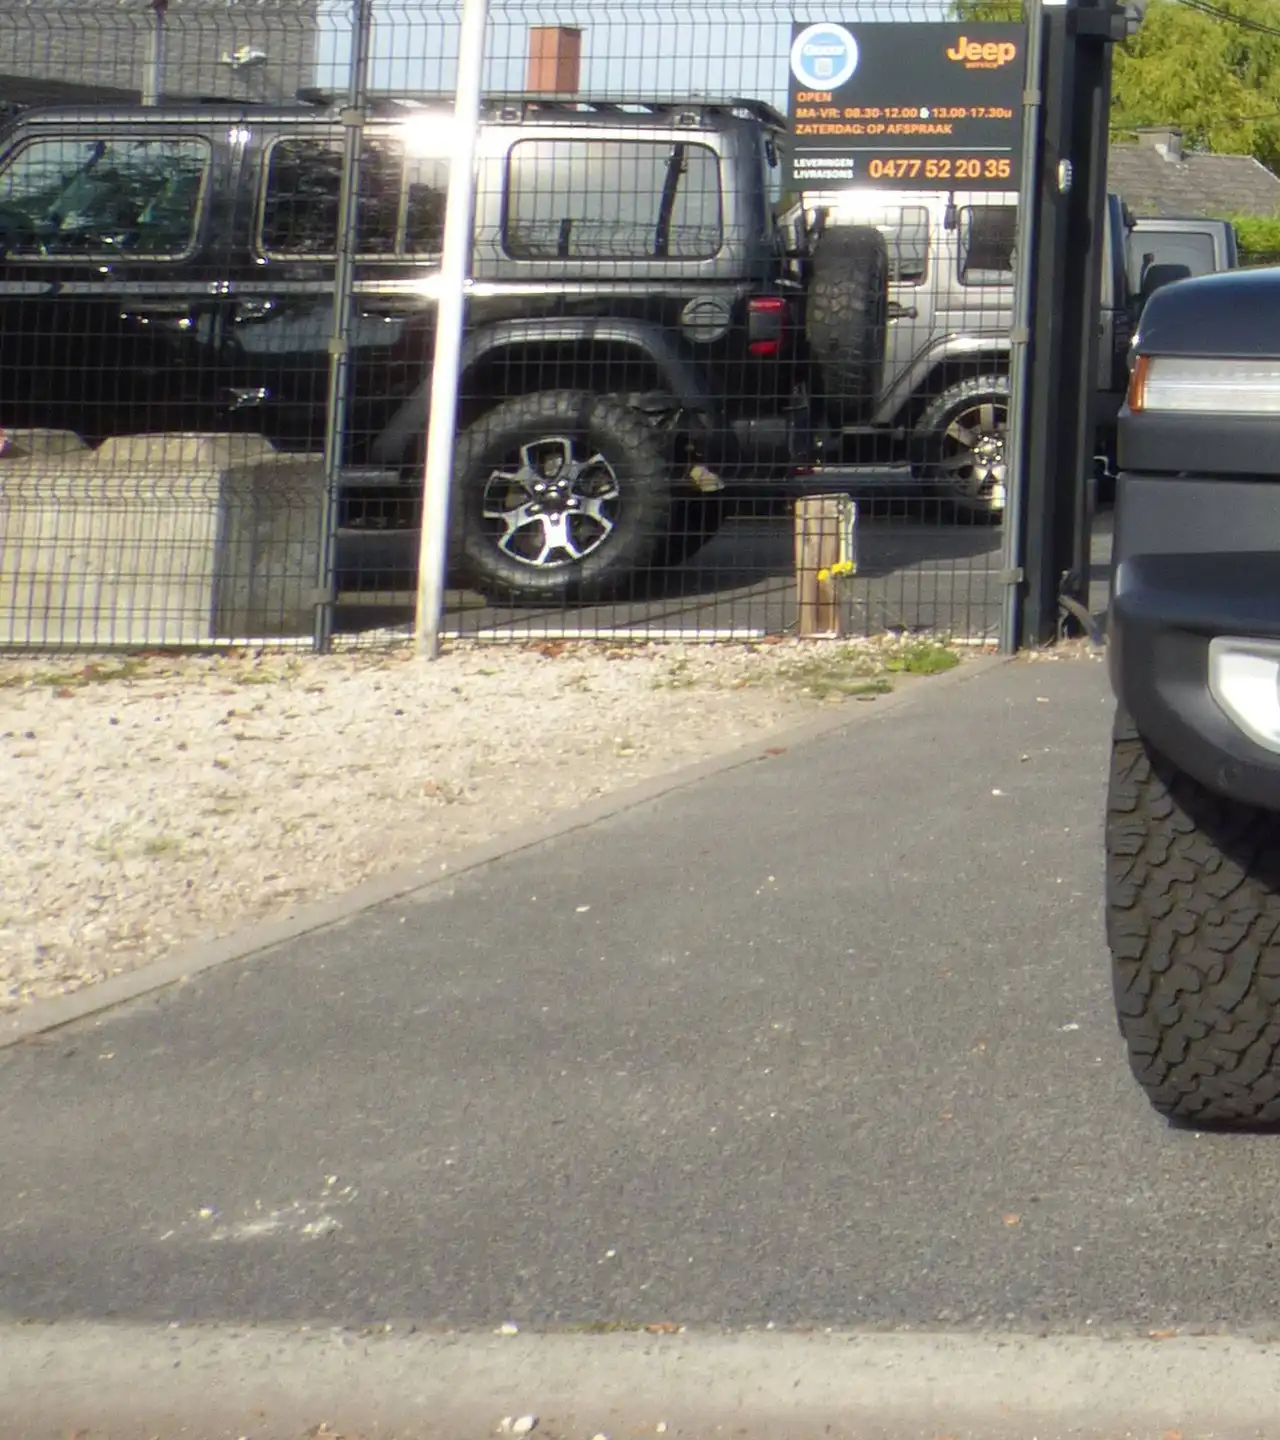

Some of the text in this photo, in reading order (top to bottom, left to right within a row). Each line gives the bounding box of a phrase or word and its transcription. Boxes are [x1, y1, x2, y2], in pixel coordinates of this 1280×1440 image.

[946, 35, 1016, 65] Jeep
[796, 91, 833, 103] OPEN
[795, 123, 953, 135] ZATERDAG: OP AFSPRAAK
[869, 159, 1011, 178] 0477 52 20 35
